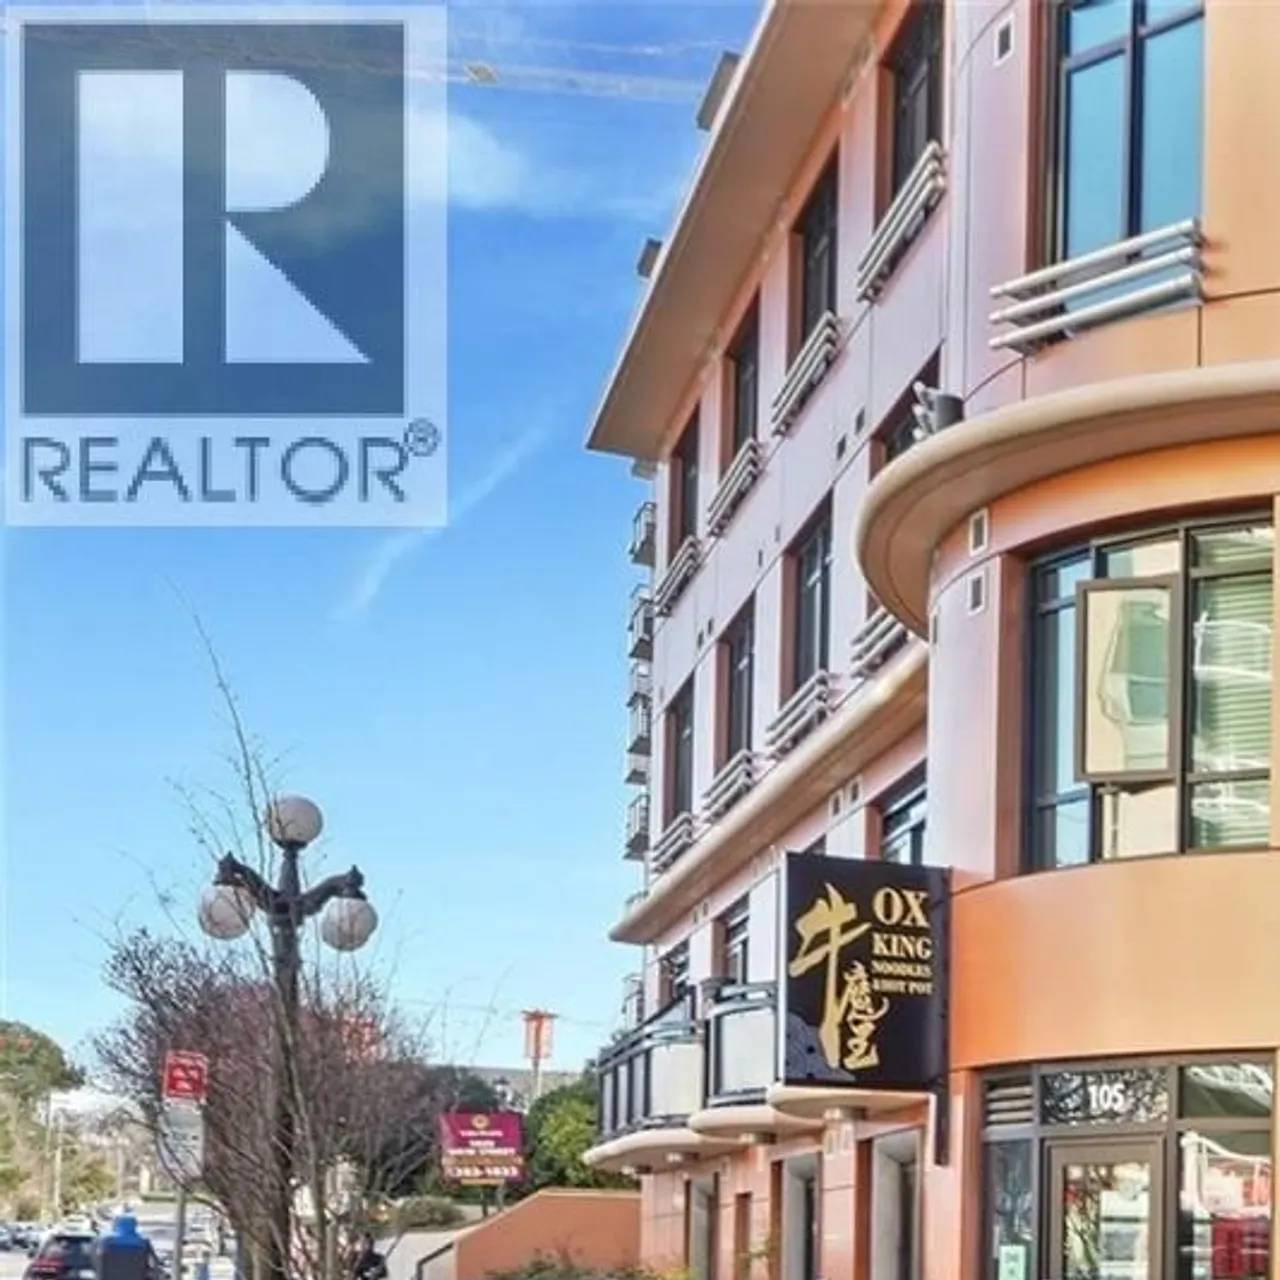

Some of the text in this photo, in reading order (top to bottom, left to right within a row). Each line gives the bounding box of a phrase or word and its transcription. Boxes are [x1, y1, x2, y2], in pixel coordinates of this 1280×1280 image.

[873, 886, 930, 928] OX
[872, 931, 931, 959] KING
[908, 981, 933, 995] POT
[1087, 1083, 1125, 1111] 105
